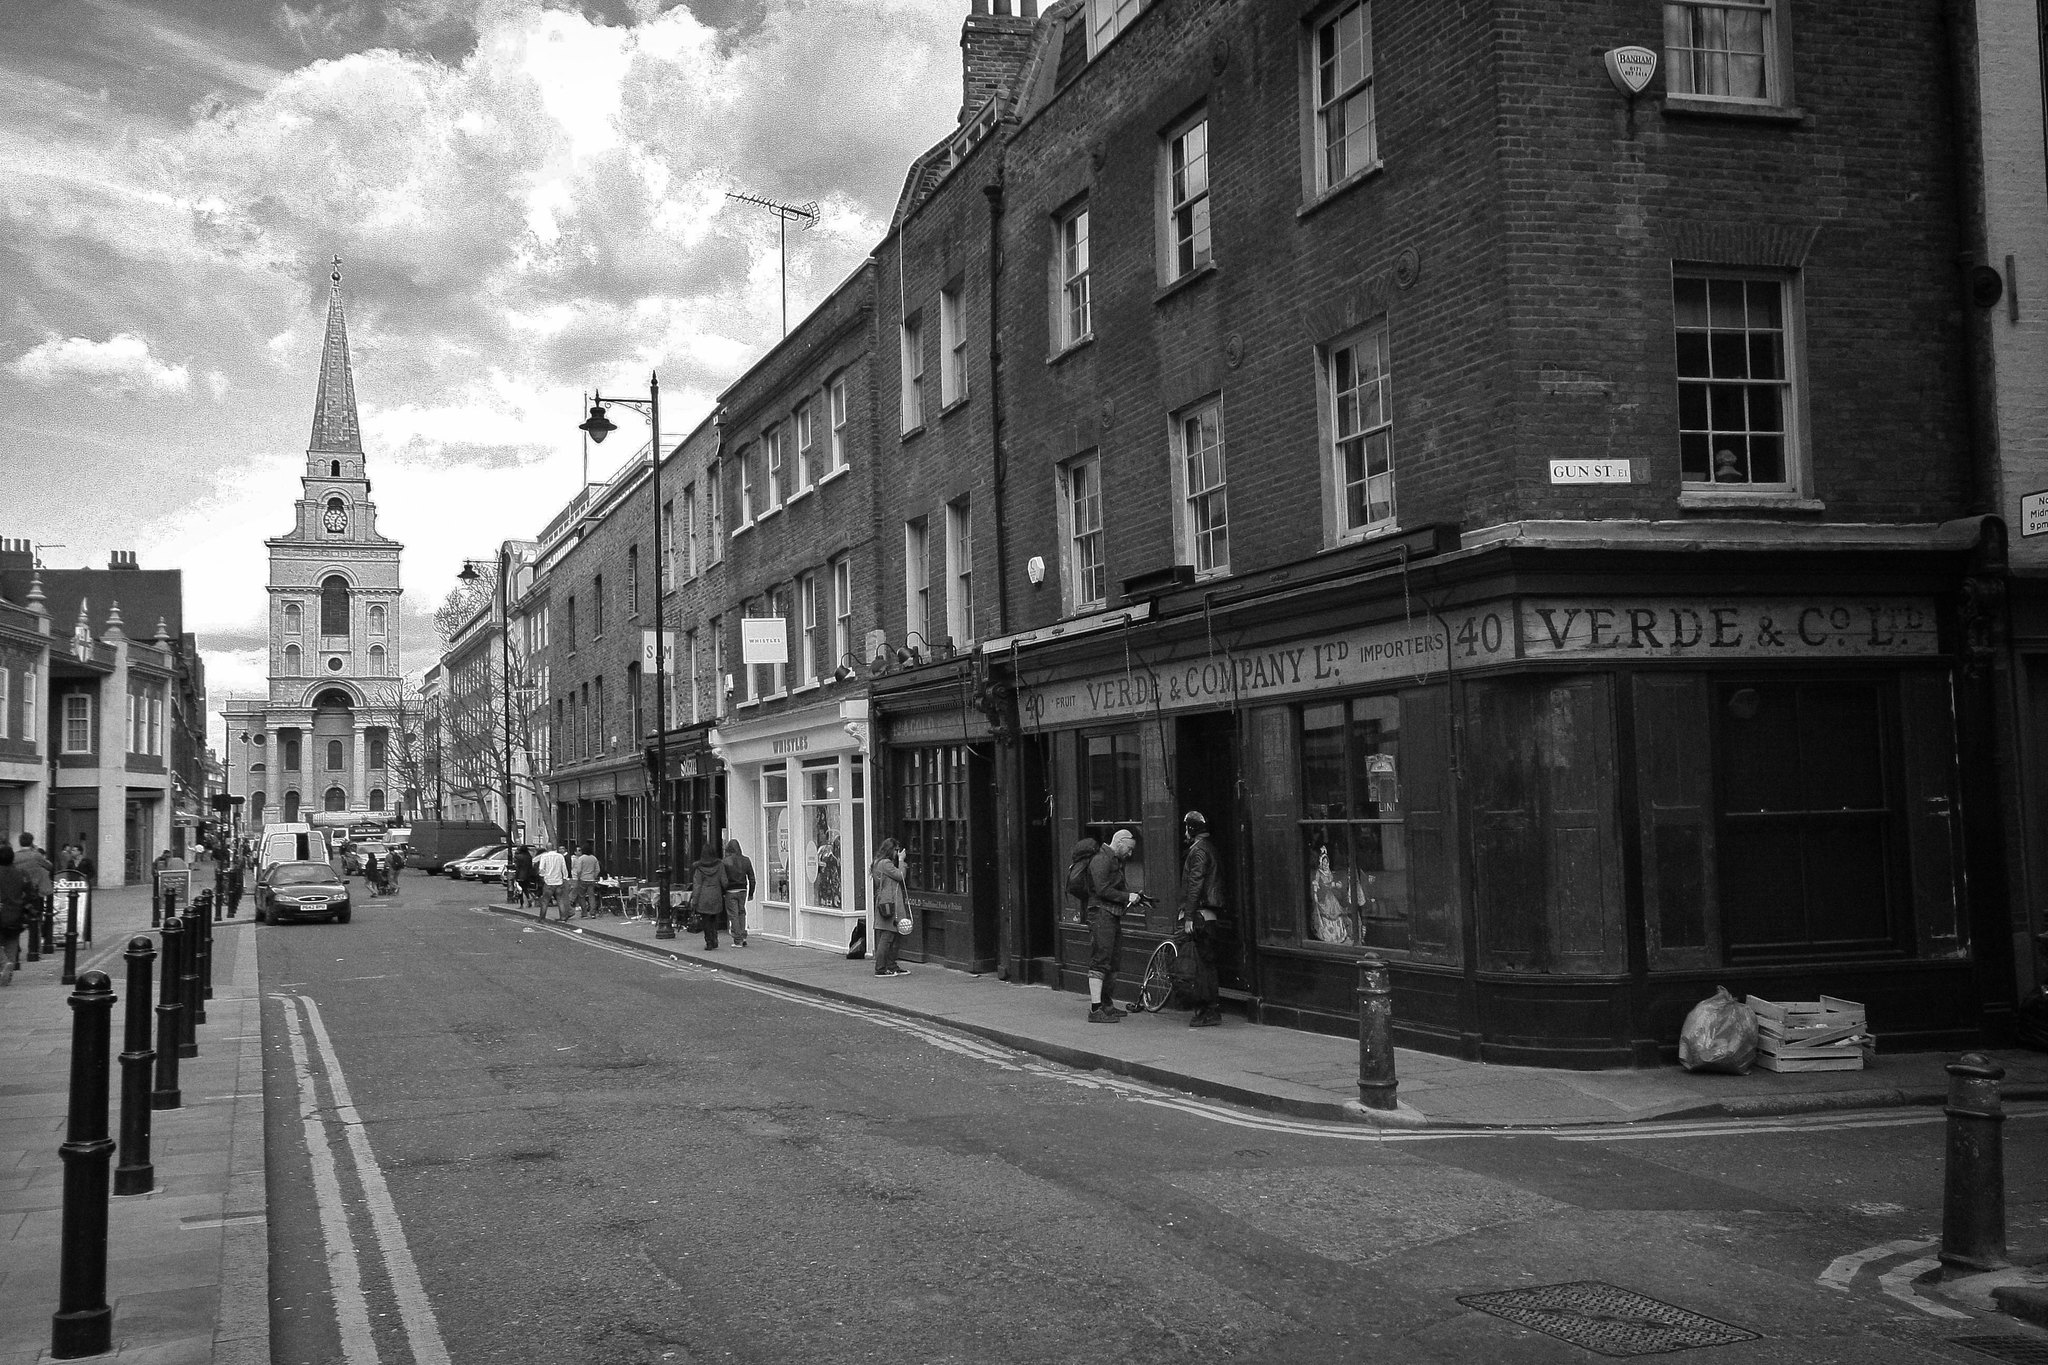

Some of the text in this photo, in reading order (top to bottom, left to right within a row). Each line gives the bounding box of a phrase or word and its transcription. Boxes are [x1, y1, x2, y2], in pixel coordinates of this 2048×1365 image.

[1619, 54, 1652, 65] BANHAM
[1553, 465, 1590, 478] GUN
[1456, 613, 1503, 657] 40
[1535, 607, 1743, 650] VERDE
[1758, 615, 1785, 647] &
[1025, 693, 1045, 720] 40
[1055, 695, 1077, 709] FRUIT
[1086, 673, 1162, 711] VERDE
[1169, 675, 1182, 701] &
[1185, 648, 1305, 698] COMPANY
[1360, 633, 1444, 663] IMPORTERS
[772, 735, 808, 754] WHISTLES
